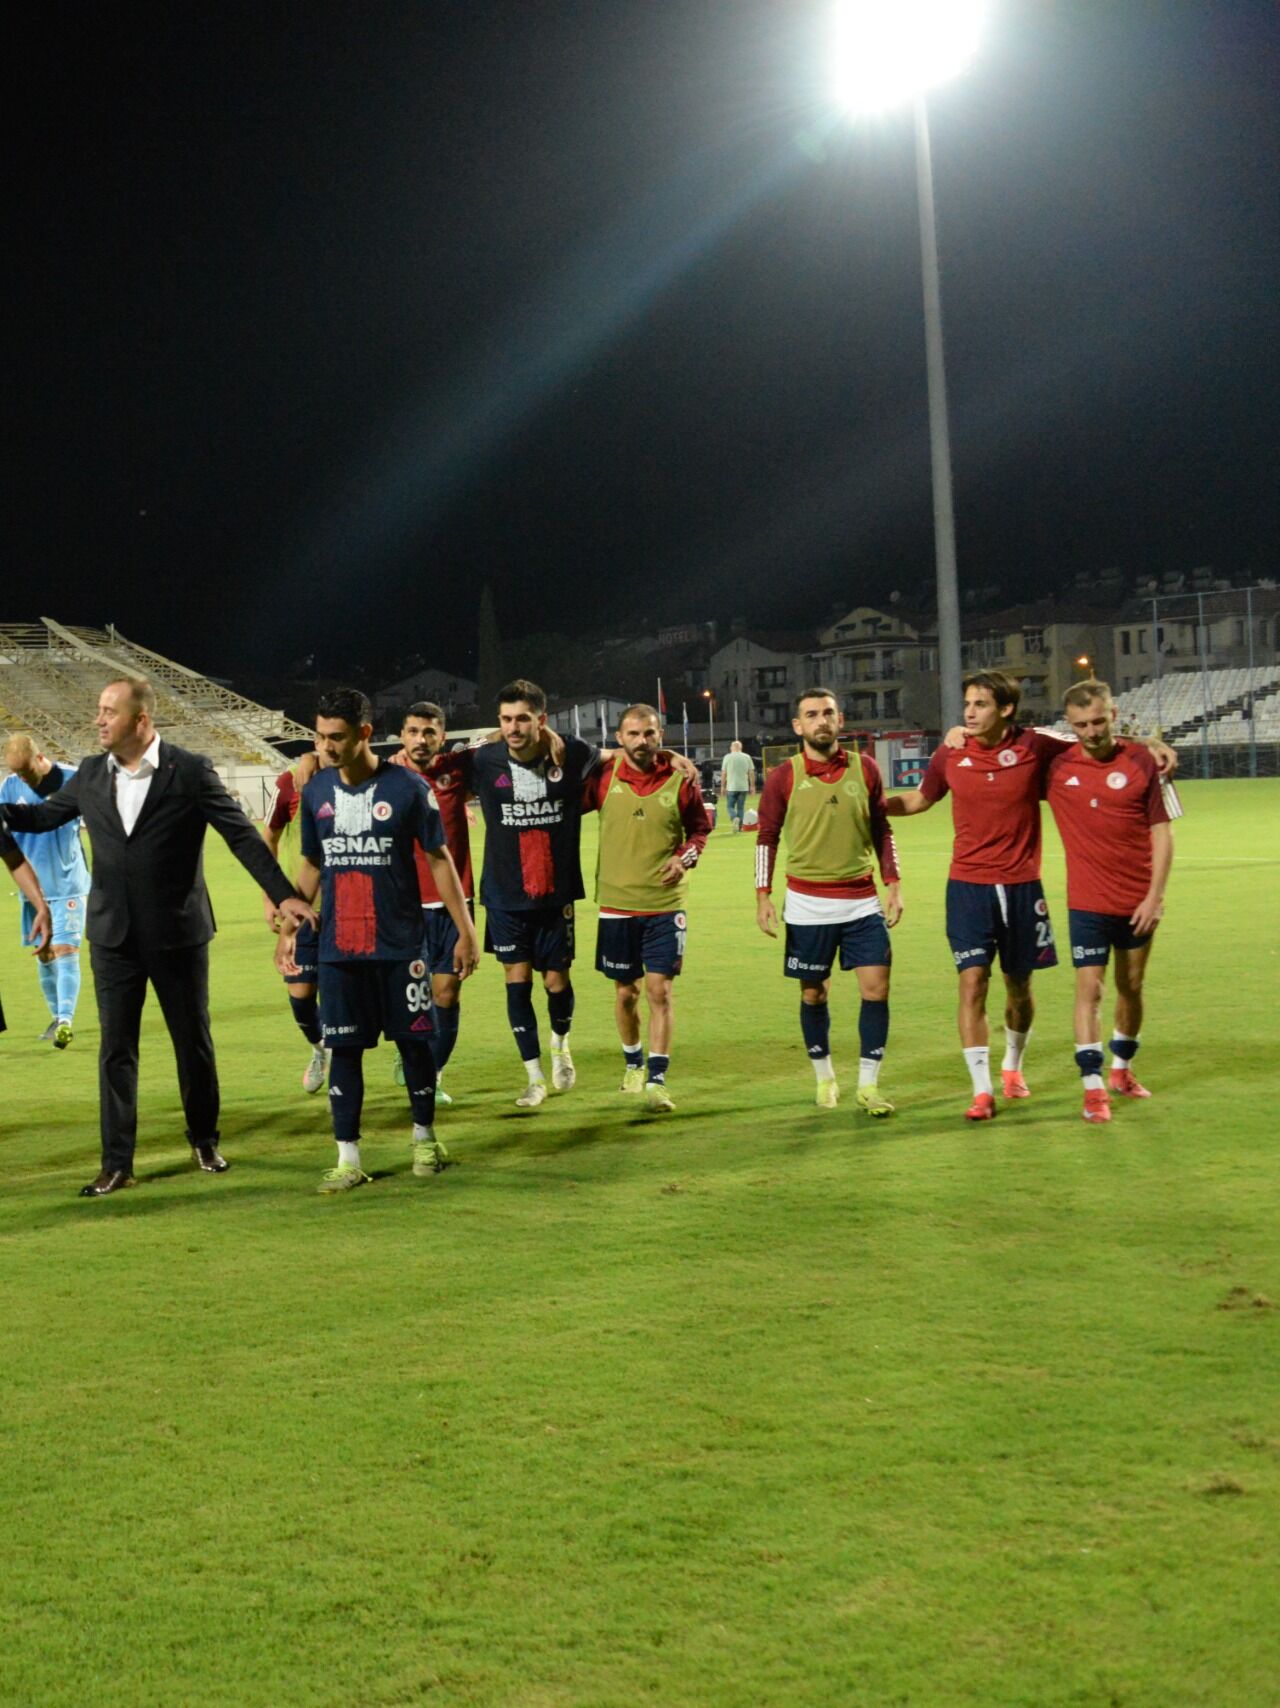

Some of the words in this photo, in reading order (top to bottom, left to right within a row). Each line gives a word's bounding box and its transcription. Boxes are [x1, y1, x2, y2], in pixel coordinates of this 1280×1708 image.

[501, 800, 563, 816] ESNAF
[321, 837, 393, 855] ESNAF
[406, 980, 432, 1013] 99
[326, 1026, 336, 1035] US
